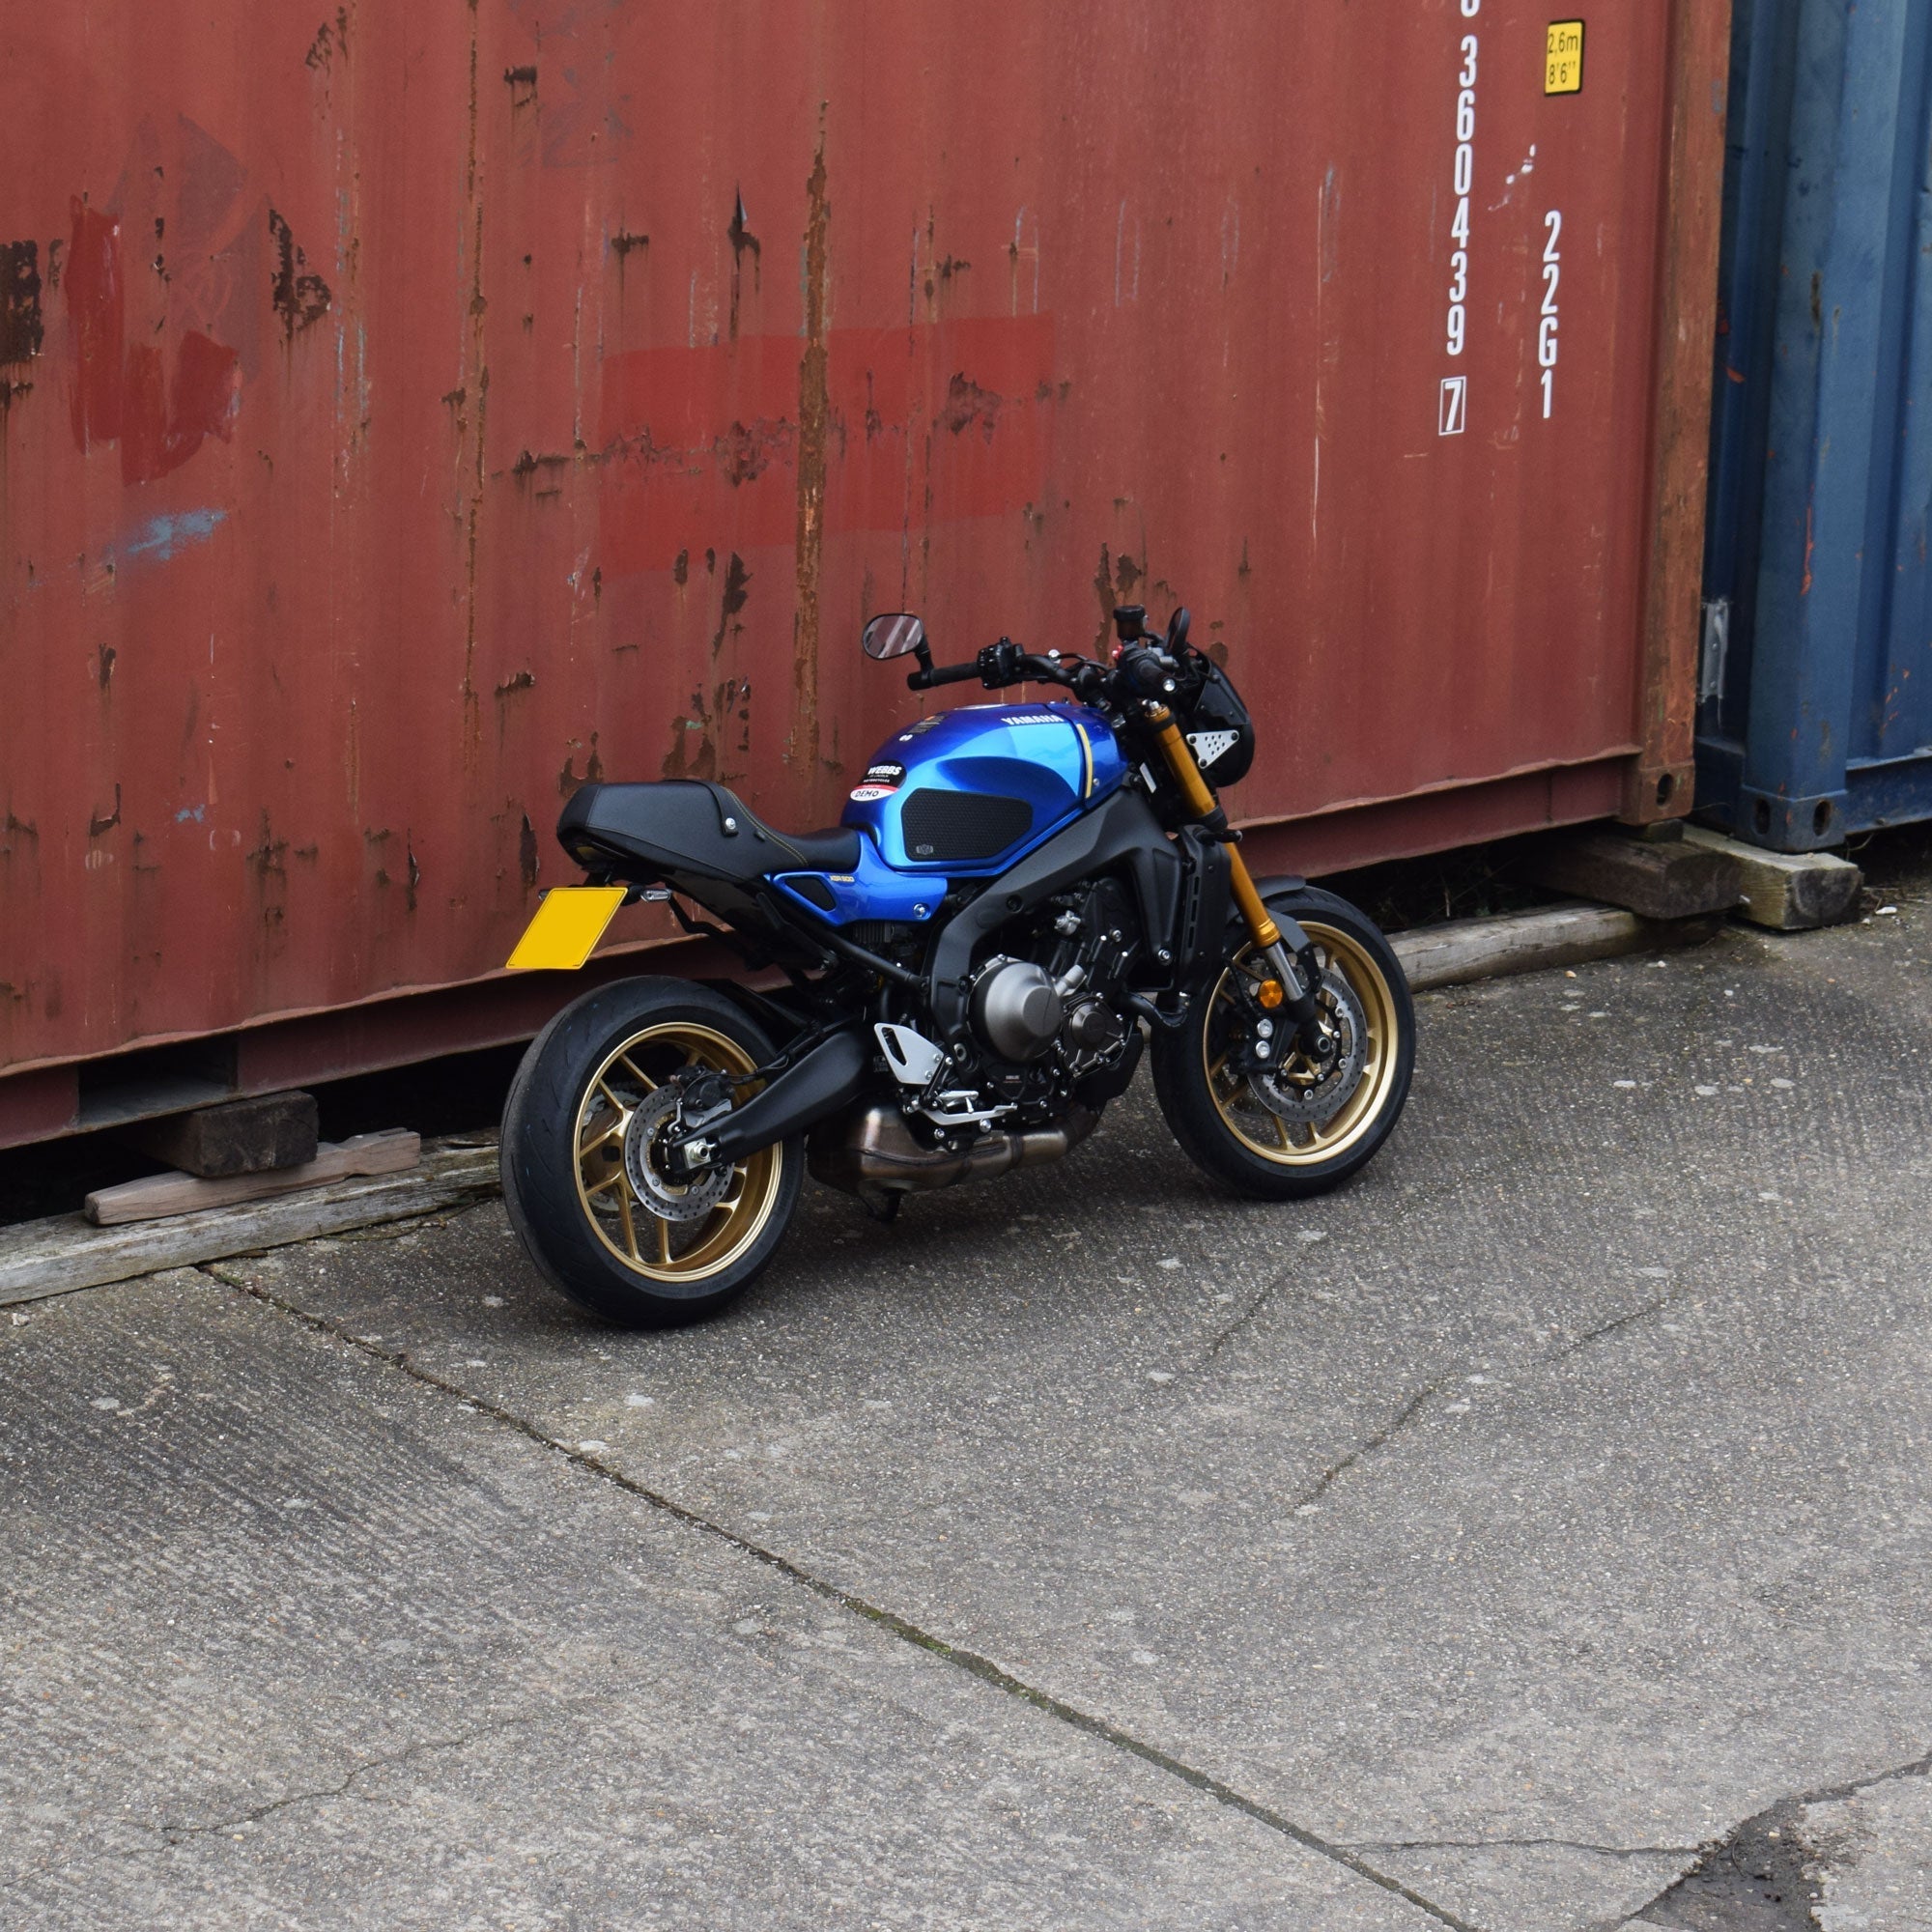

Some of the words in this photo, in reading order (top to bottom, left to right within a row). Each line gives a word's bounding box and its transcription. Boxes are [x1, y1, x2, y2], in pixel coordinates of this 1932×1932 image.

[1446, 35, 1478, 355] 360439
[1538, 210, 1562, 419] 22G1
[1443, 379, 1463, 433] 7
[1001, 715, 1064, 724] YAMAHA
[867, 765, 902, 775] WEBBS
